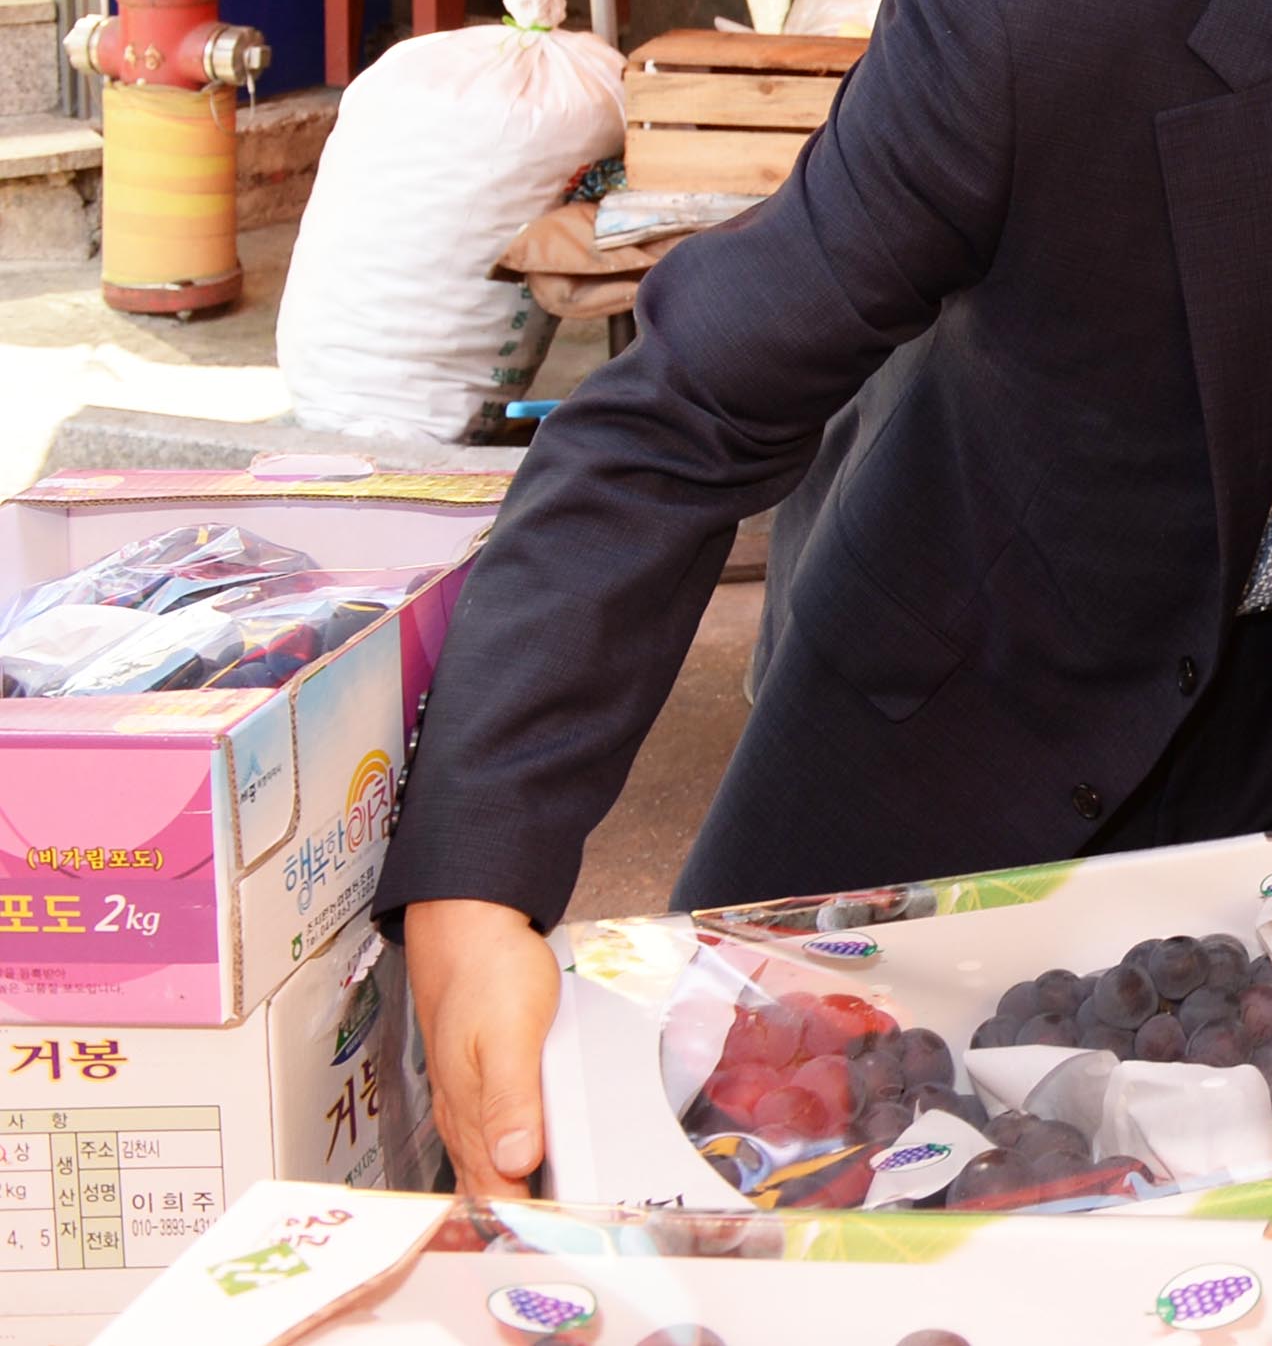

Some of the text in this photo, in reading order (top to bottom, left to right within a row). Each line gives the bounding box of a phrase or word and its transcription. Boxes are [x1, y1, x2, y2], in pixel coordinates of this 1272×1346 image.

[27, 847, 164, 870] (비가림포도)
[283, 819, 346, 916] 행복한
[0, 894, 160, 936] 포도 2kg
[10, 1038, 128, 1082] 거봉
[14, 1142, 30, 1162] 상
[80, 1140, 161, 1159] 주소 김천시
[83, 1183, 116, 1203] 성명
[86, 1231, 119, 1251] 전화
